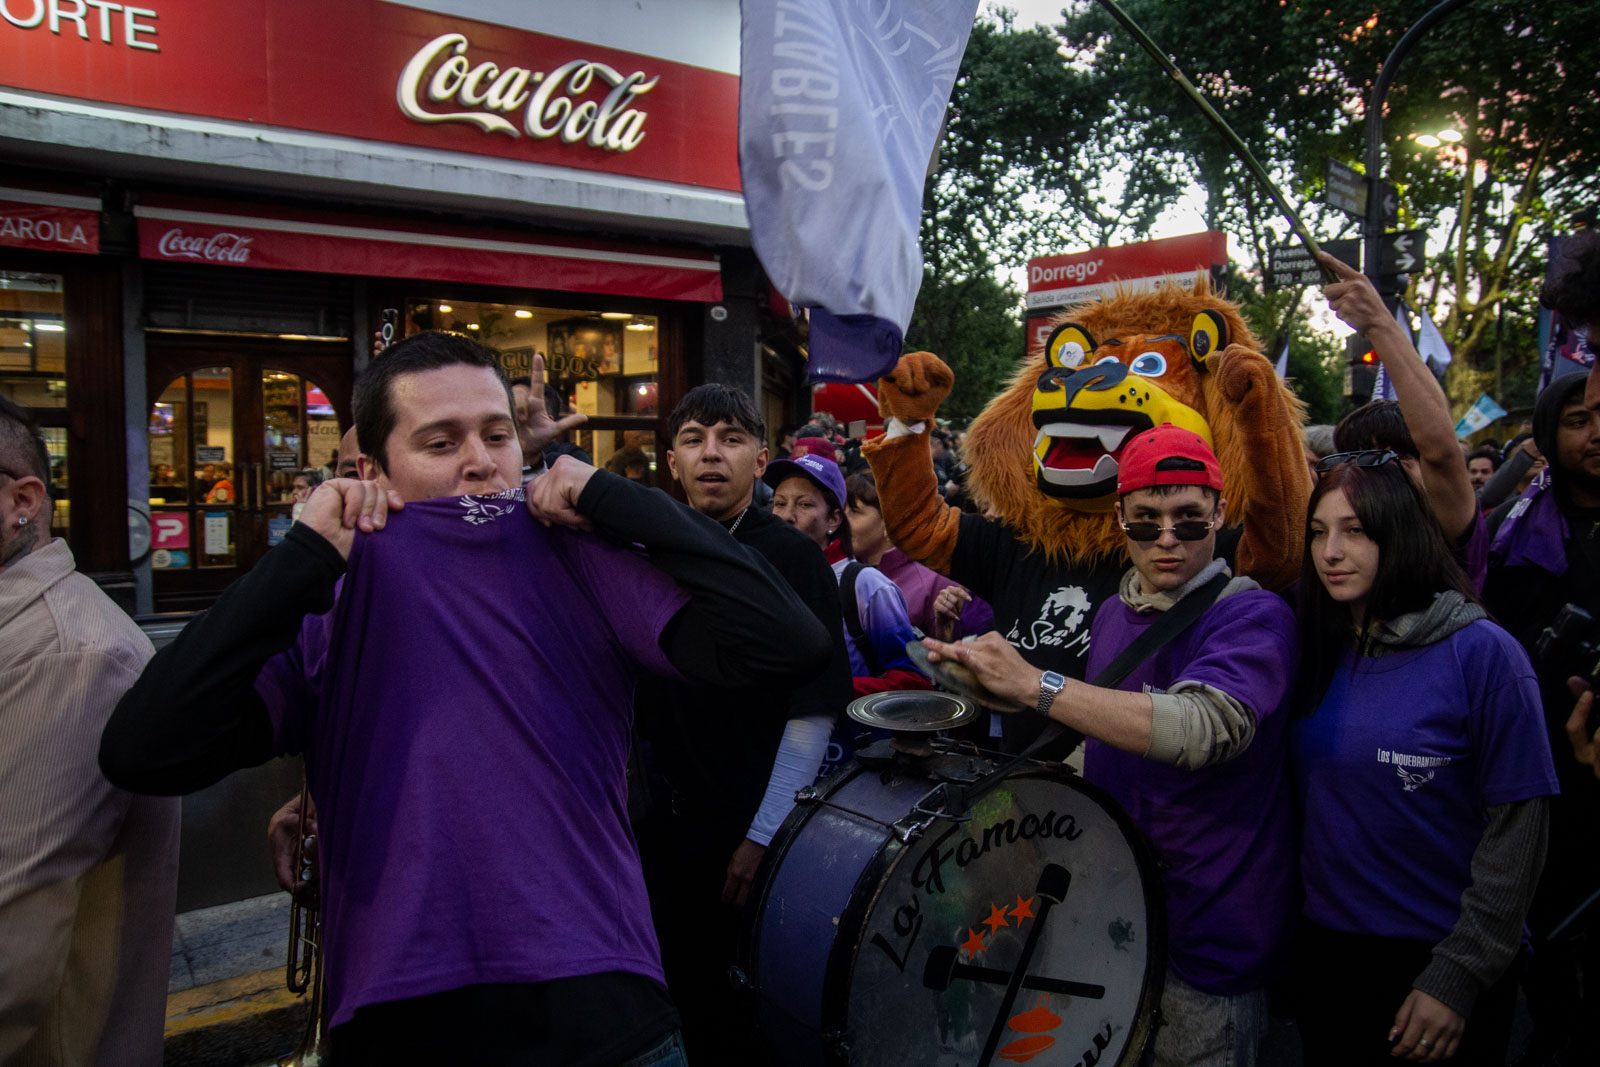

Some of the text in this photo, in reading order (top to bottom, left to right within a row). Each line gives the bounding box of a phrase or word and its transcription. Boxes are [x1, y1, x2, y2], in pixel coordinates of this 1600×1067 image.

[396, 33, 661, 152] Coca-Cola
[0, 216, 88, 245] AROLA
[158, 228, 253, 263] Coca-Cola
[1273, 272, 1293, 286] 700
[870, 809, 1083, 973] La Famosa
